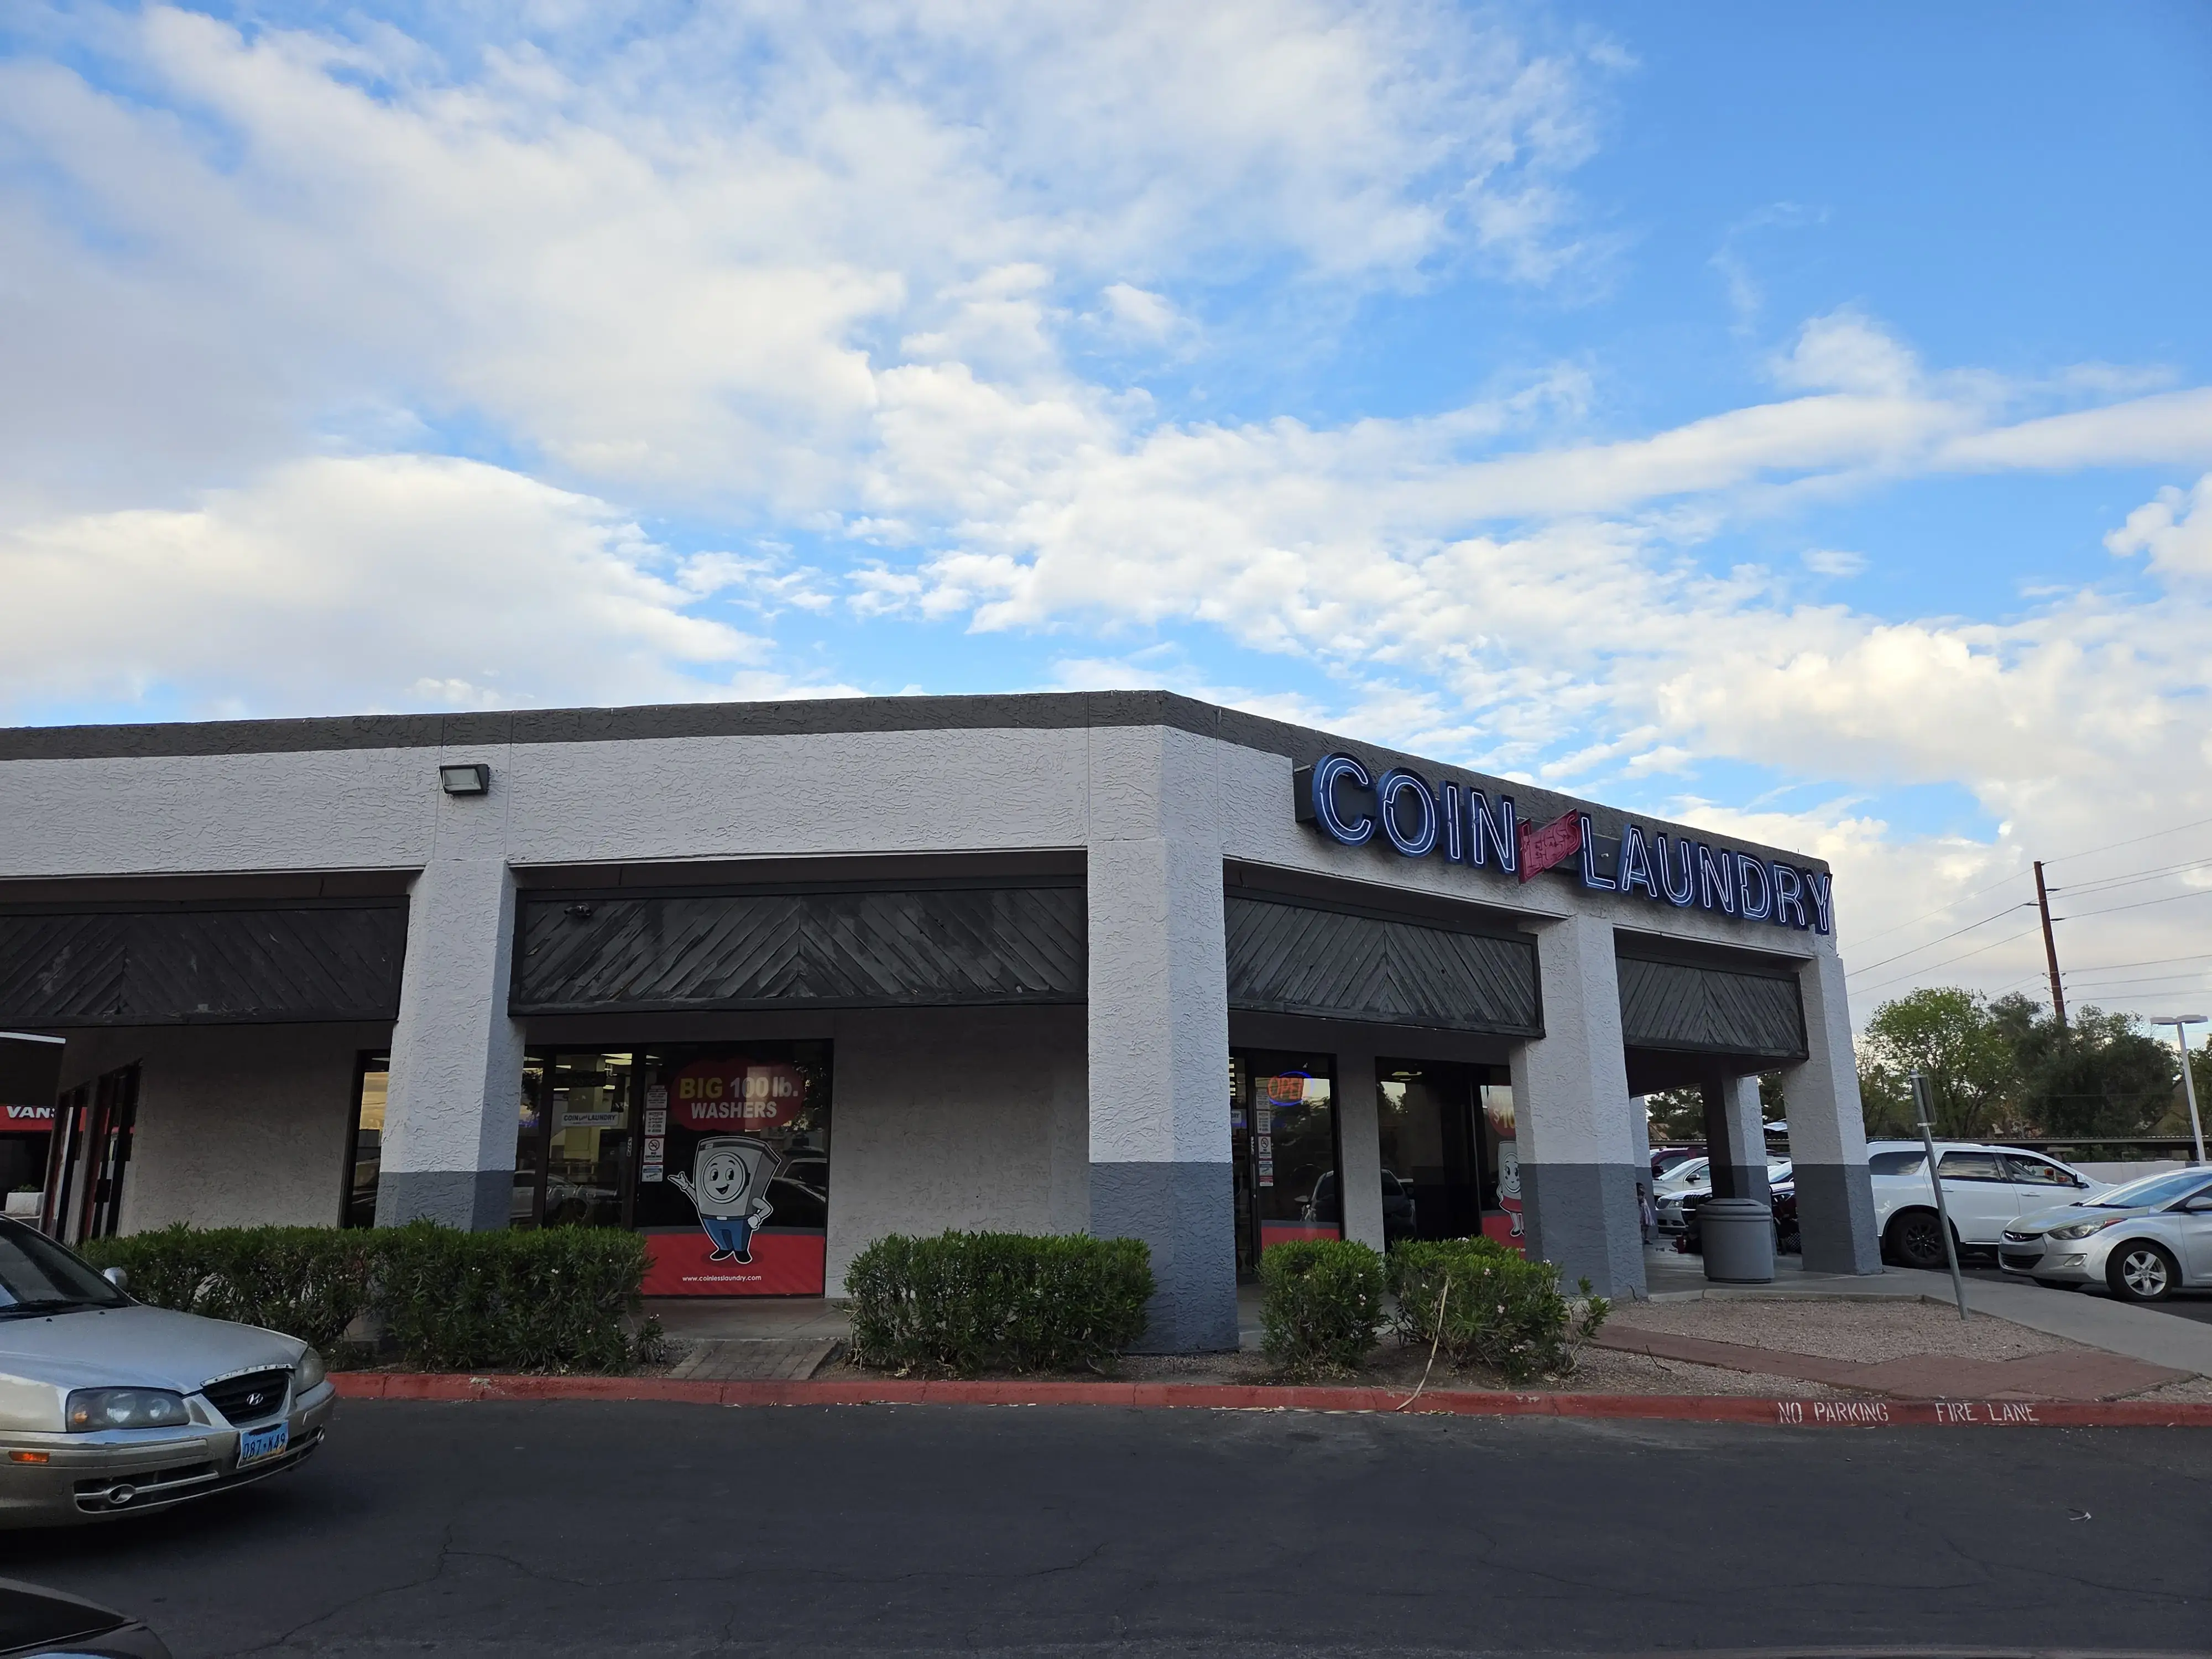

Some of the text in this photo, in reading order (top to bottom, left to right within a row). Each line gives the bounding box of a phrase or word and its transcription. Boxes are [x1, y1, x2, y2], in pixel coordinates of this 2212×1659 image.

[1312, 752, 1519, 876] COIN
[1579, 813, 1832, 935] LAUNDRY
[680, 1078, 723, 1099] BIG
[729, 1077, 769, 1098] 100
[691, 1102, 777, 1119] WASHERS
[1778, 1402, 1888, 1423] NO PARKING
[1935, 1402, 2040, 1422] FIRE LANE
